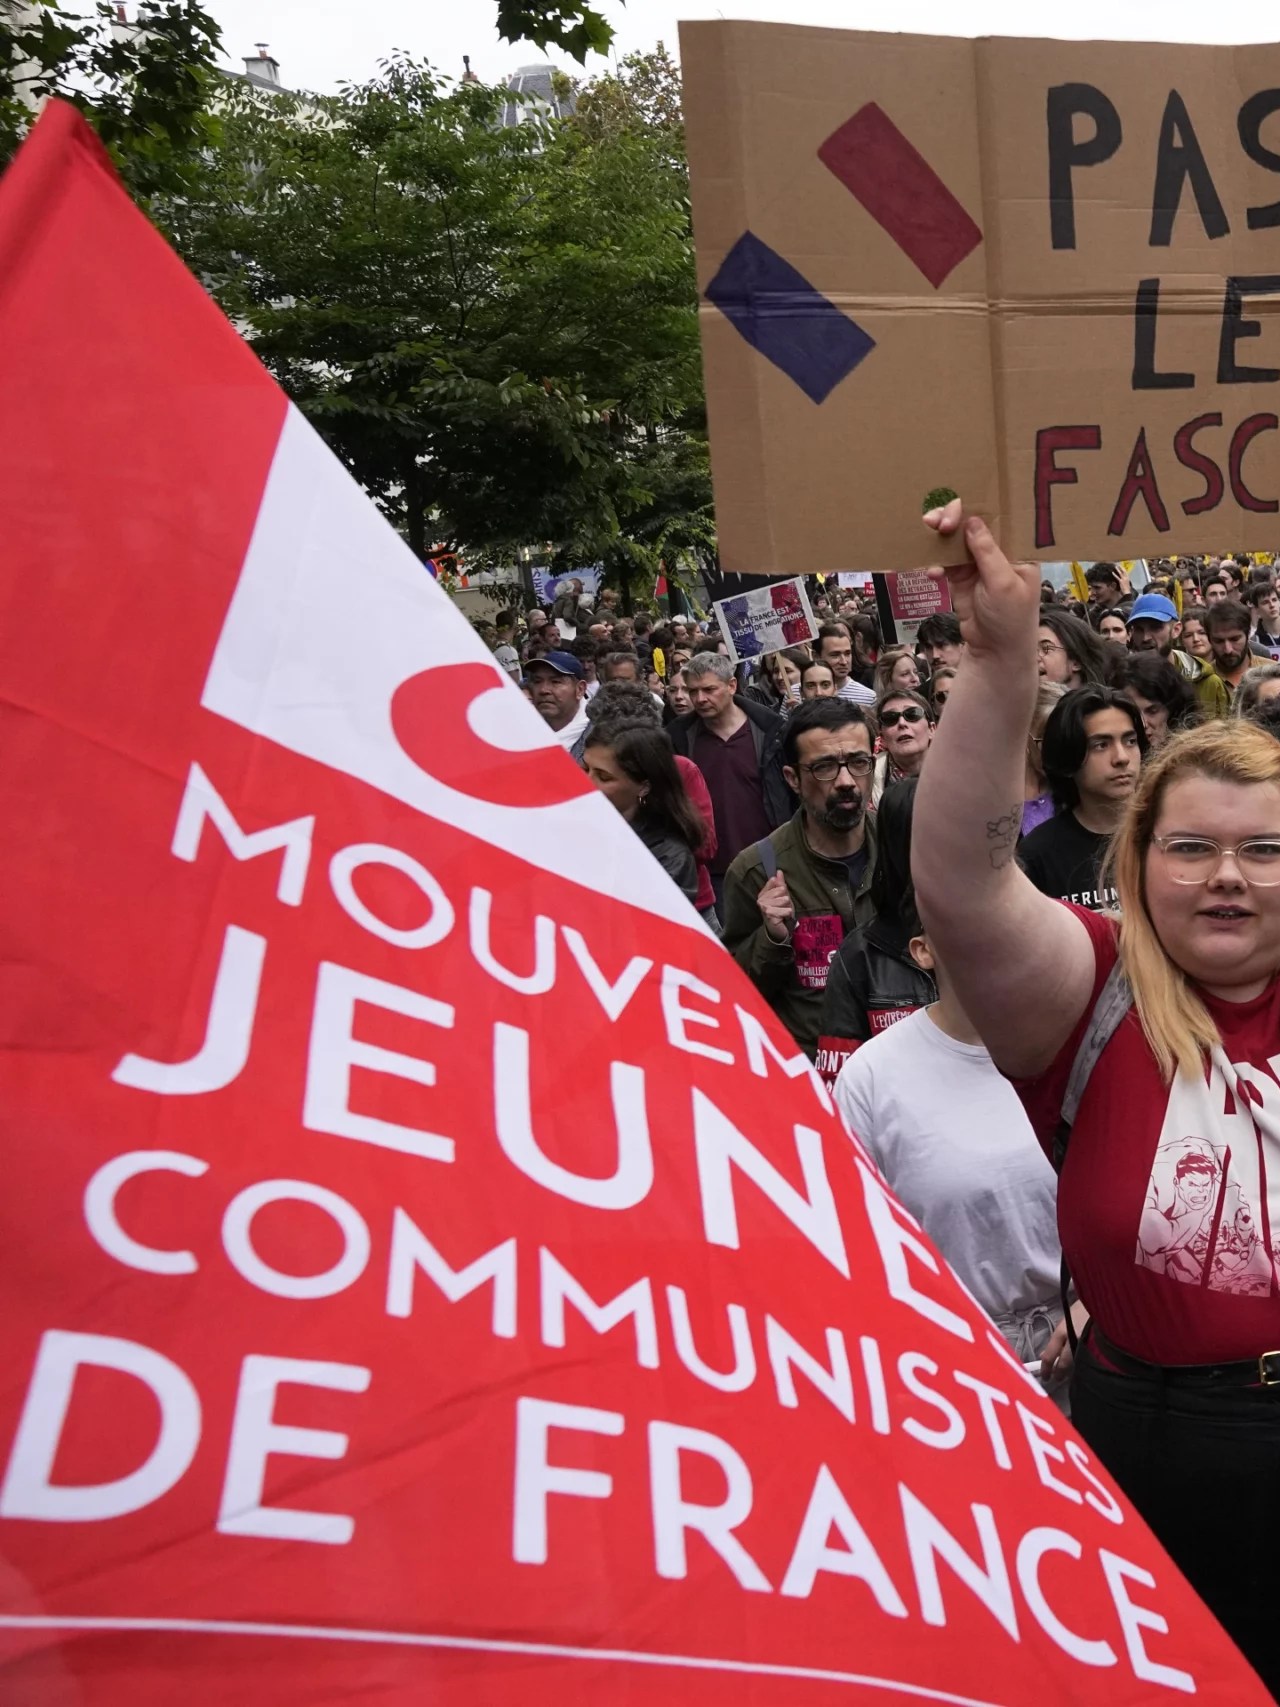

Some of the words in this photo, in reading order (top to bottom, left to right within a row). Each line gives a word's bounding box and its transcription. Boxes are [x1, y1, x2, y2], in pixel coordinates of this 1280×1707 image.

[733, 626, 753, 638] TISSU
[754, 623, 764, 631] DE
[765, 611, 804, 628] MIGRATIONS
[739, 618, 749, 626] LA
[750, 610, 776, 624] FRANCE
[776, 606, 790, 616] EST
[171, 762, 836, 1117] MOUVEM
[86, 1150, 1124, 1525] COMMUNISTES
[111, 923, 1048, 1396] JEUNE
[0, 1328, 372, 1545] DE
[513, 1396, 1197, 1694] FRANCE
